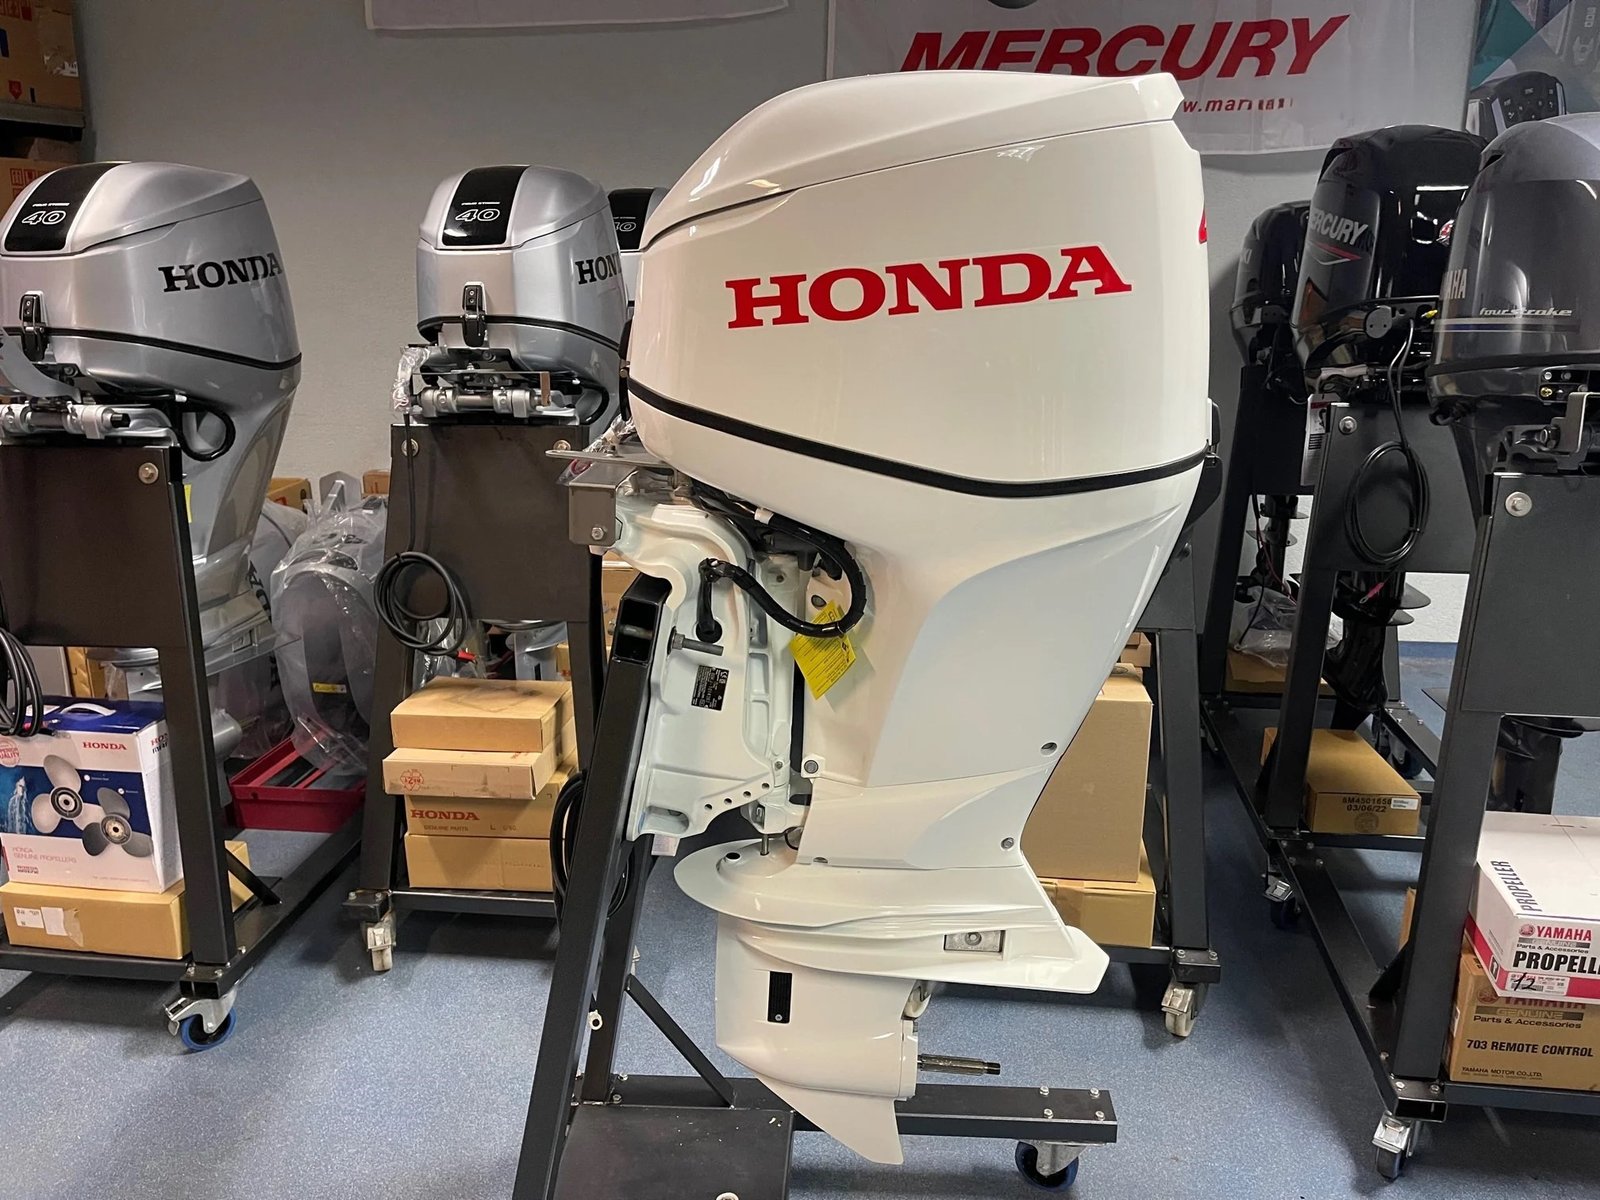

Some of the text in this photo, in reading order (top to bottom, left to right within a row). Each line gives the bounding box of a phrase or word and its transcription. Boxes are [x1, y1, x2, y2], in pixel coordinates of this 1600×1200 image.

[900, 15, 1350, 81] MERCURY
[22, 210, 67, 225] 40
[455, 208, 501, 222] 40
[1310, 208, 1369, 245] ERCURY
[158, 252, 283, 293] HONDA
[574, 251, 622, 285] HON
[725, 244, 1133, 330] HONDA
[82, 741, 128, 751] HONDA
[410, 809, 481, 821] HONDA
[1346, 804, 1387, 813] 03/06/22
[1490, 860, 1543, 912] PROPELLER
[1536, 925, 1592, 941] YAMAHA
[1516, 943, 1536, 951] Parts
[1544, 945, 1590, 954] Accessories
[1513, 950, 1600, 975] PROPELL
[1473, 1014, 1502, 1024] Parts
[1515, 1018, 1582, 1029] Accessories
[1466, 1039, 1594, 1058] 703 REMOTE CONTROL
[1461, 1066, 1489, 1074] YAMAHA
